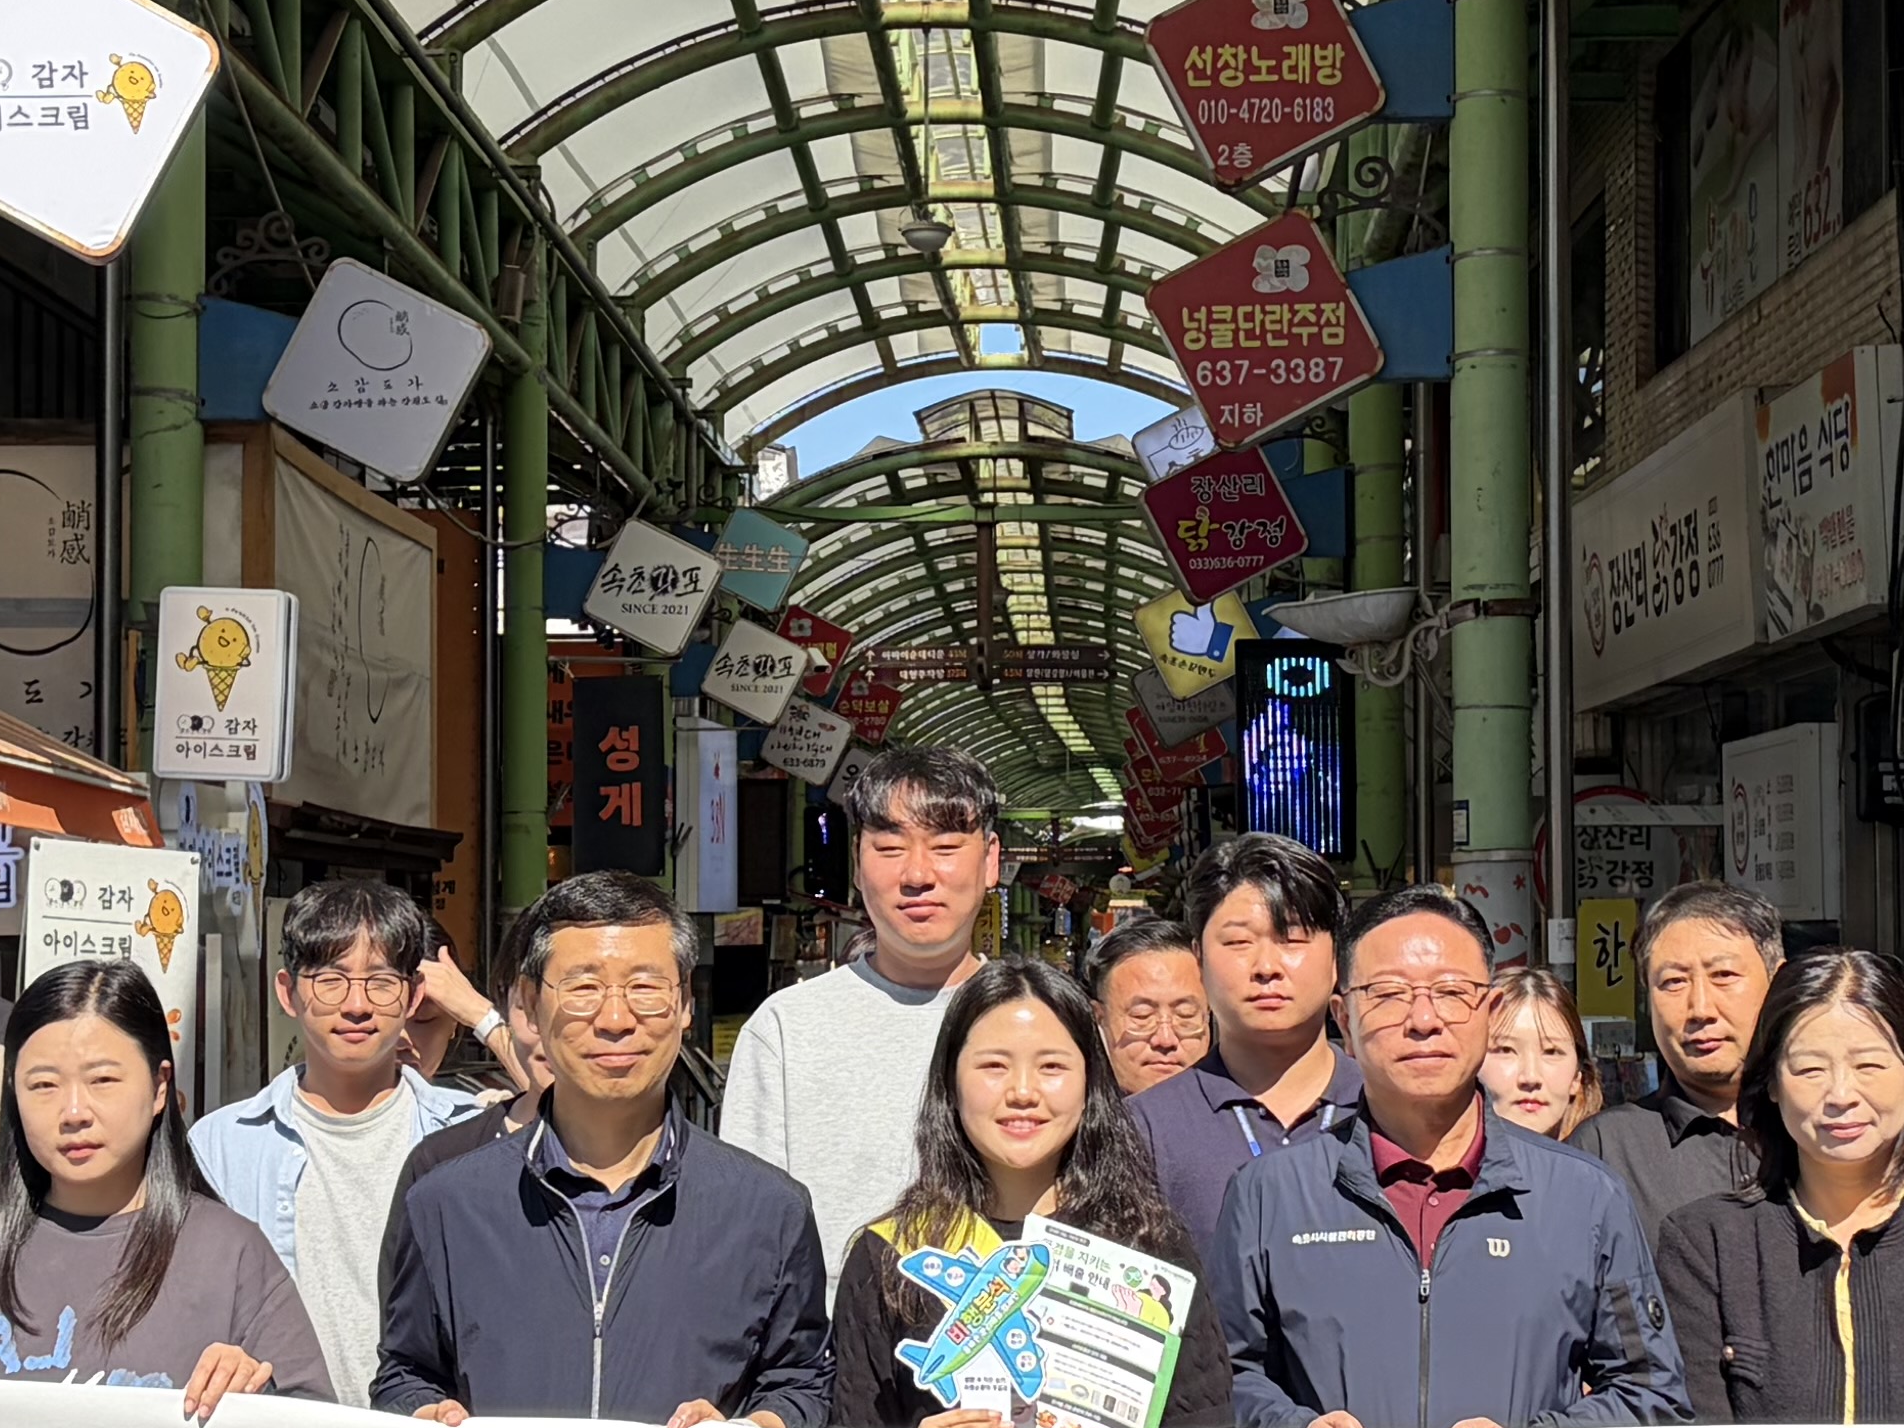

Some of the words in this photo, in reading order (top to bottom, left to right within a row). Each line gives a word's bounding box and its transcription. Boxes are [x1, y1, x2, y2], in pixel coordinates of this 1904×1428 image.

[32, 60, 88, 89] 감자
[1184, 43, 1345, 87] 선창노래방
[1198, 96, 1335, 124] 010-4720-6183
[1217, 143, 1253, 168] 2층
[1182, 301, 1346, 351] 넝쿨단란주점
[1196, 357, 1344, 387] 637-3387
[1220, 401, 1264, 429] 지하
[1763, 425, 1813, 510] 한마음
[1817, 394, 1850, 479] 식당
[1190, 473, 1265, 504] 장산리
[1177, 514, 1287, 553] 닭강정
[1608, 541, 1648, 635] 장산리
[621, 603, 657, 614] SINCE
[662, 604, 689, 615] 2021
[731, 683, 760, 694] SINCE
[224, 717, 258, 736] 감자
[176, 741, 258, 761] 아이스크림
[598, 724, 644, 829] 성게
[98, 884, 134, 912] 감자
[43, 928, 134, 961] 아이스크림
